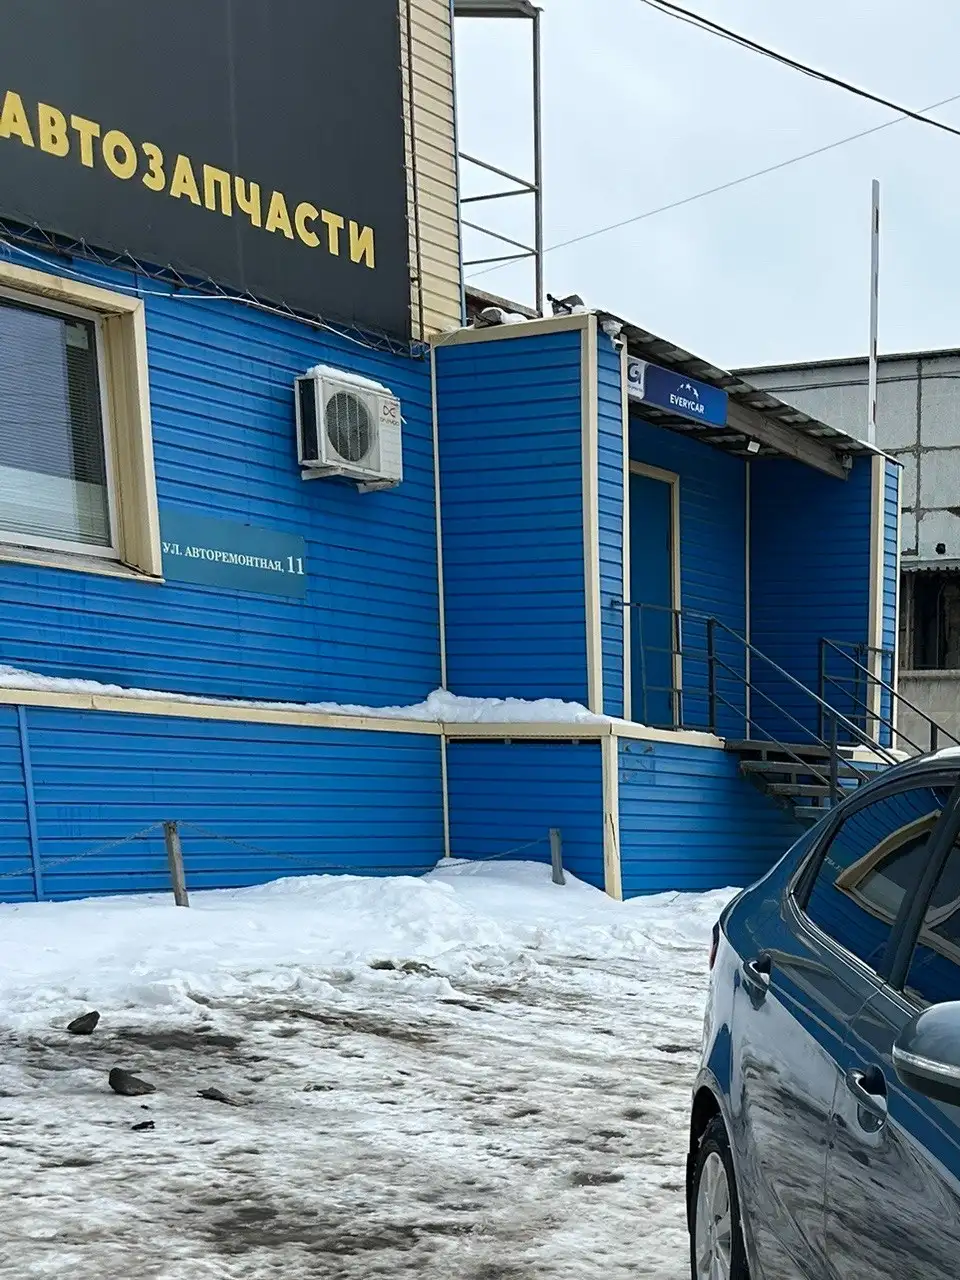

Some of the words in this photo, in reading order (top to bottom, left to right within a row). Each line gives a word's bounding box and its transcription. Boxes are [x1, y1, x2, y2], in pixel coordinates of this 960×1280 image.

[0, 90, 375, 269] АВТОЗАПЧАСТИ
[669, 394, 705, 414] EVERYCAR
[162, 541, 183, 556] УЛ.
[185, 546, 284, 573] АВТОРЕМОНТНАЯ,
[287, 555, 305, 575] 11
